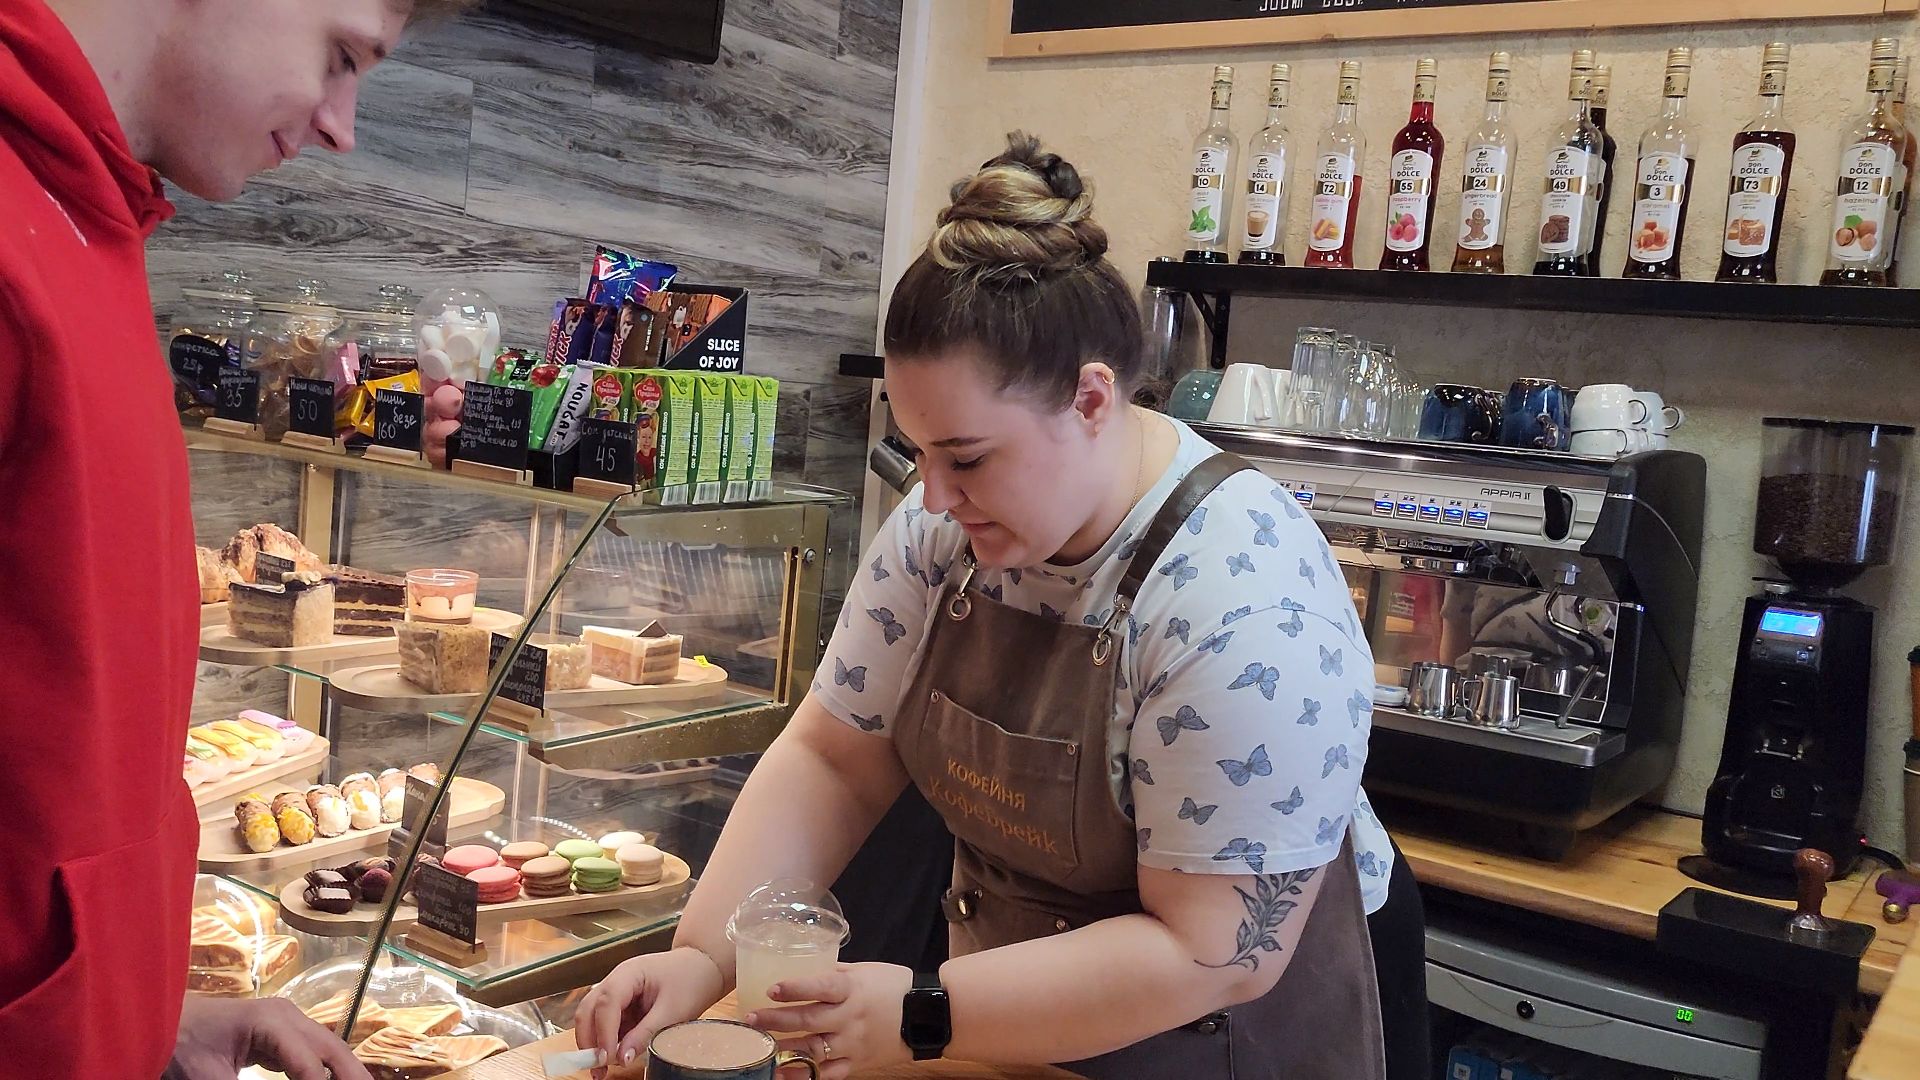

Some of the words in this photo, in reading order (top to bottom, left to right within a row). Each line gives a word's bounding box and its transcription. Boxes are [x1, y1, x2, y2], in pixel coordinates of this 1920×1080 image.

[1470, 166, 1496, 174] DOLCE
[1740, 167, 1770, 175] DOLCE
[1849, 167, 1881, 175] DOLCE
[1199, 178, 1209, 186] 10
[1646, 174, 1675, 182] DOLCE
[1256, 184, 1265, 192] 14
[1324, 184, 1335, 193] 72
[1401, 182, 1413, 191] 55
[1474, 179, 1487, 188] 24
[1553, 181, 1566, 190] 49
[1745, 180, 1759, 190] 73
[1856, 181, 1869, 191] 12
[1654, 187, 1661, 197] 3
[707, 338, 740, 352] SLICE
[699, 355, 714, 368] OF
[715, 356, 739, 370] JOY
[297, 398, 319, 421] 50
[556, 382, 589, 441] NOUGAT
[393, 406, 417, 429] безе
[378, 421, 396, 440] 160
[595, 445, 617, 472] 45
[1480, 488, 1522, 500] APPIA
[947, 759, 1026, 812] КОФЕЙНЯ
[928, 776, 1058, 855] Кофебрейк
